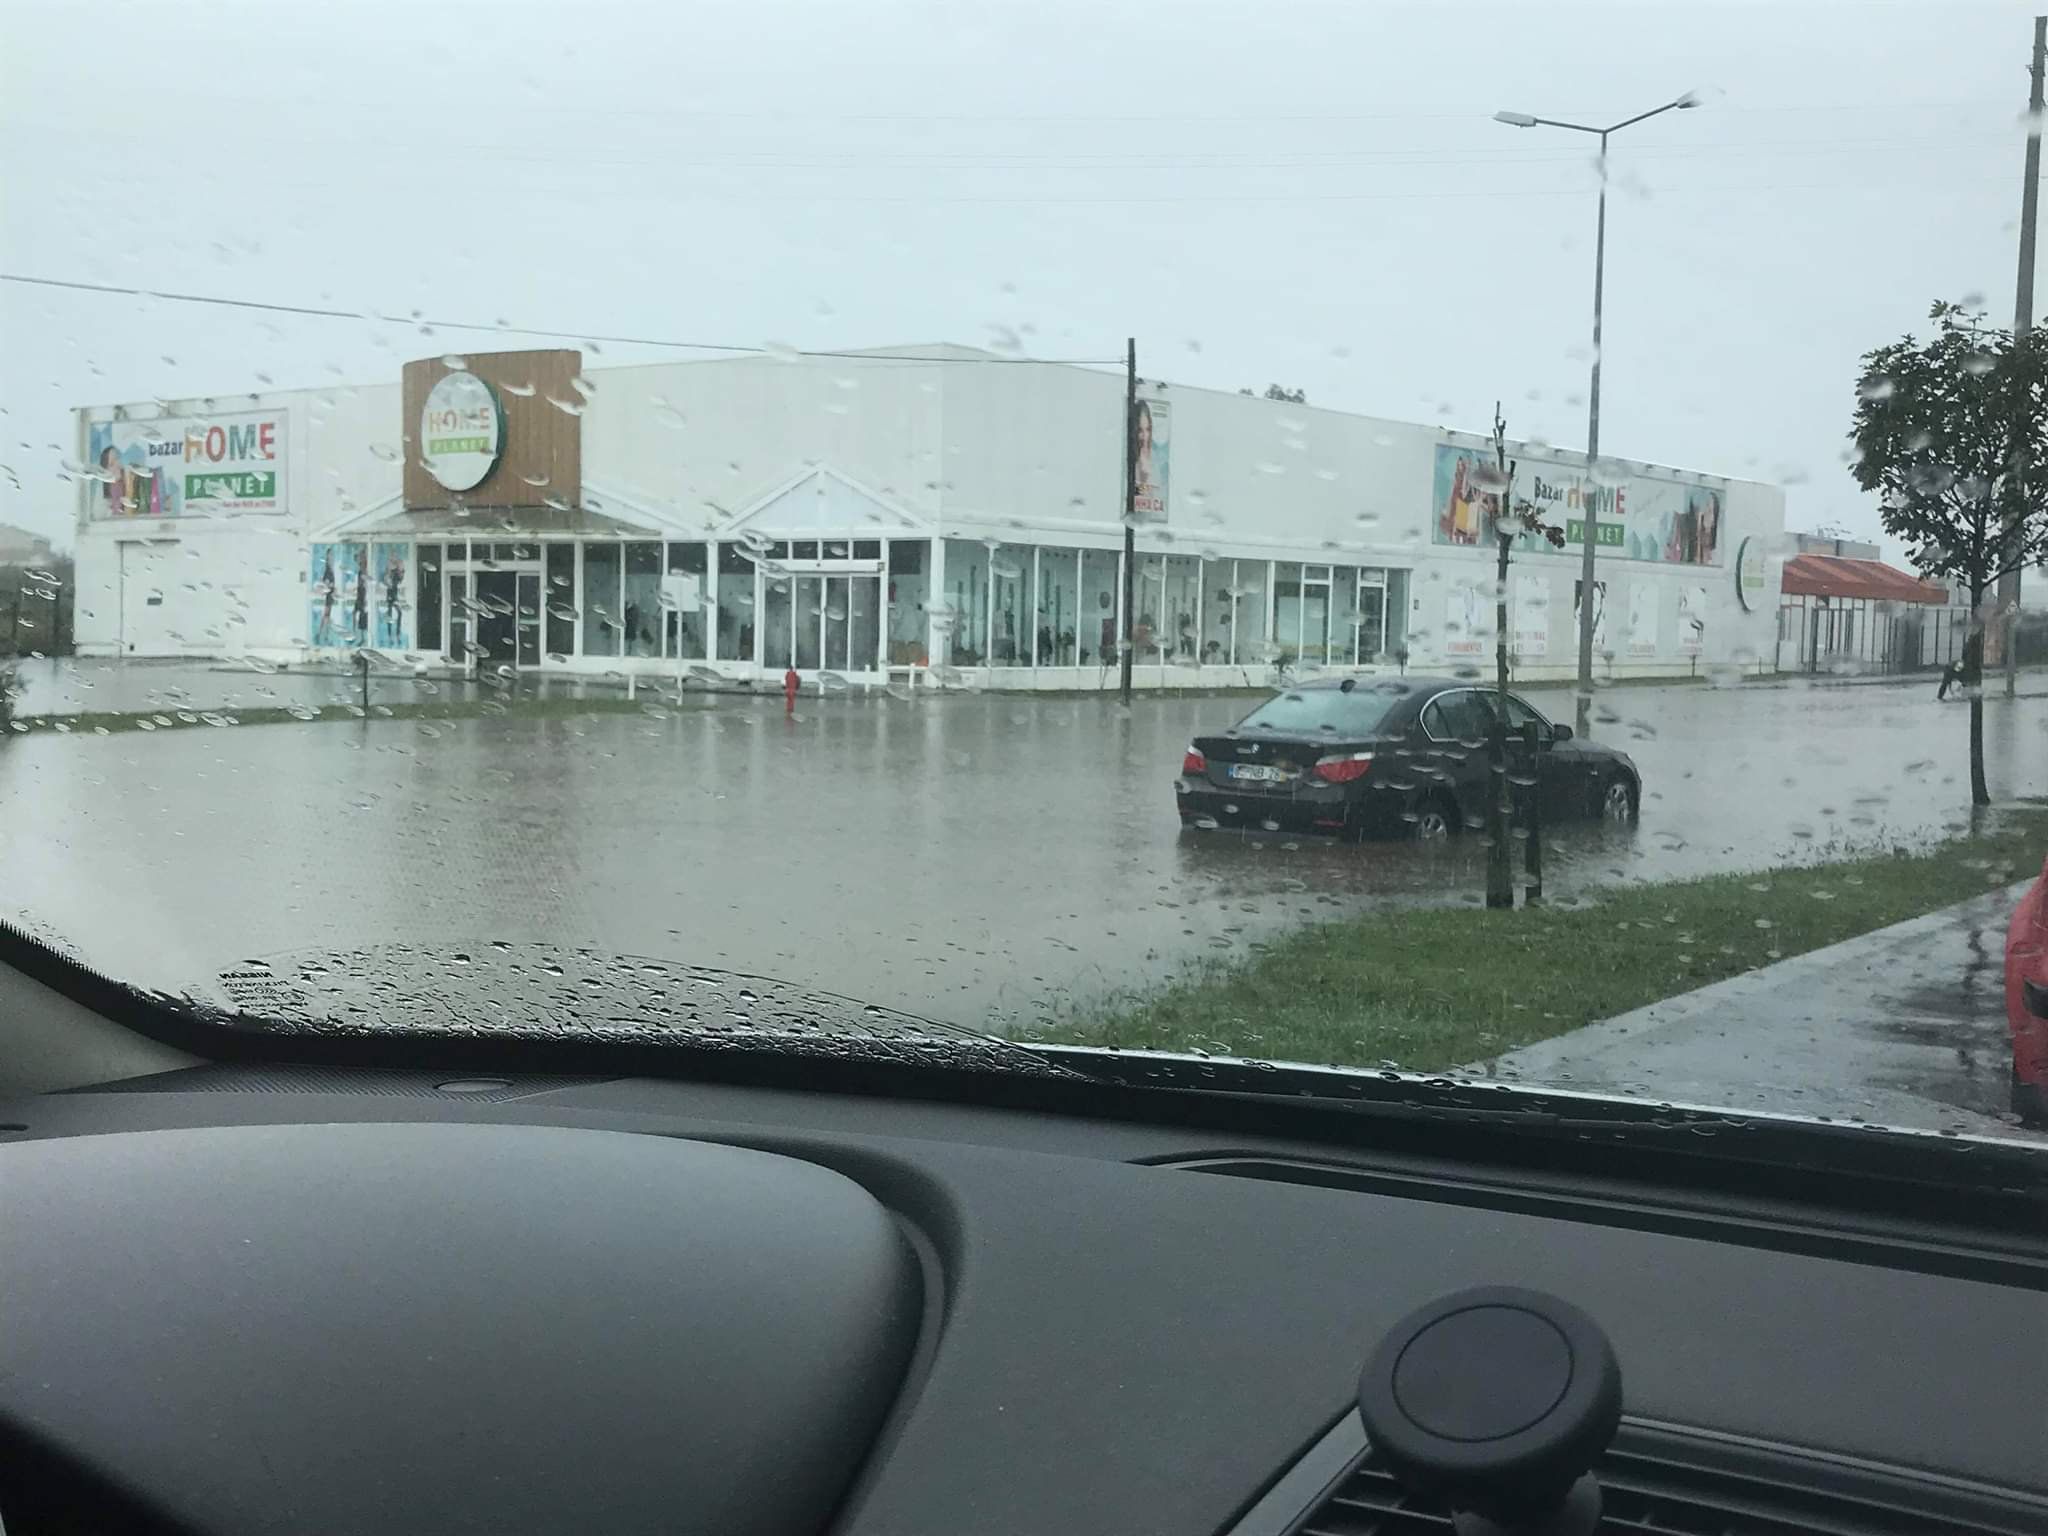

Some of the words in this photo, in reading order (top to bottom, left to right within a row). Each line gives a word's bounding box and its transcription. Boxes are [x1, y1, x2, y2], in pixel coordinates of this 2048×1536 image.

[429, 407, 489, 432] HOME
[185, 422, 275, 463] HOME
[1534, 476, 1564, 501] Bazar
[1567, 475, 1625, 514] HME
[1571, 524, 1621, 544] PLNET
